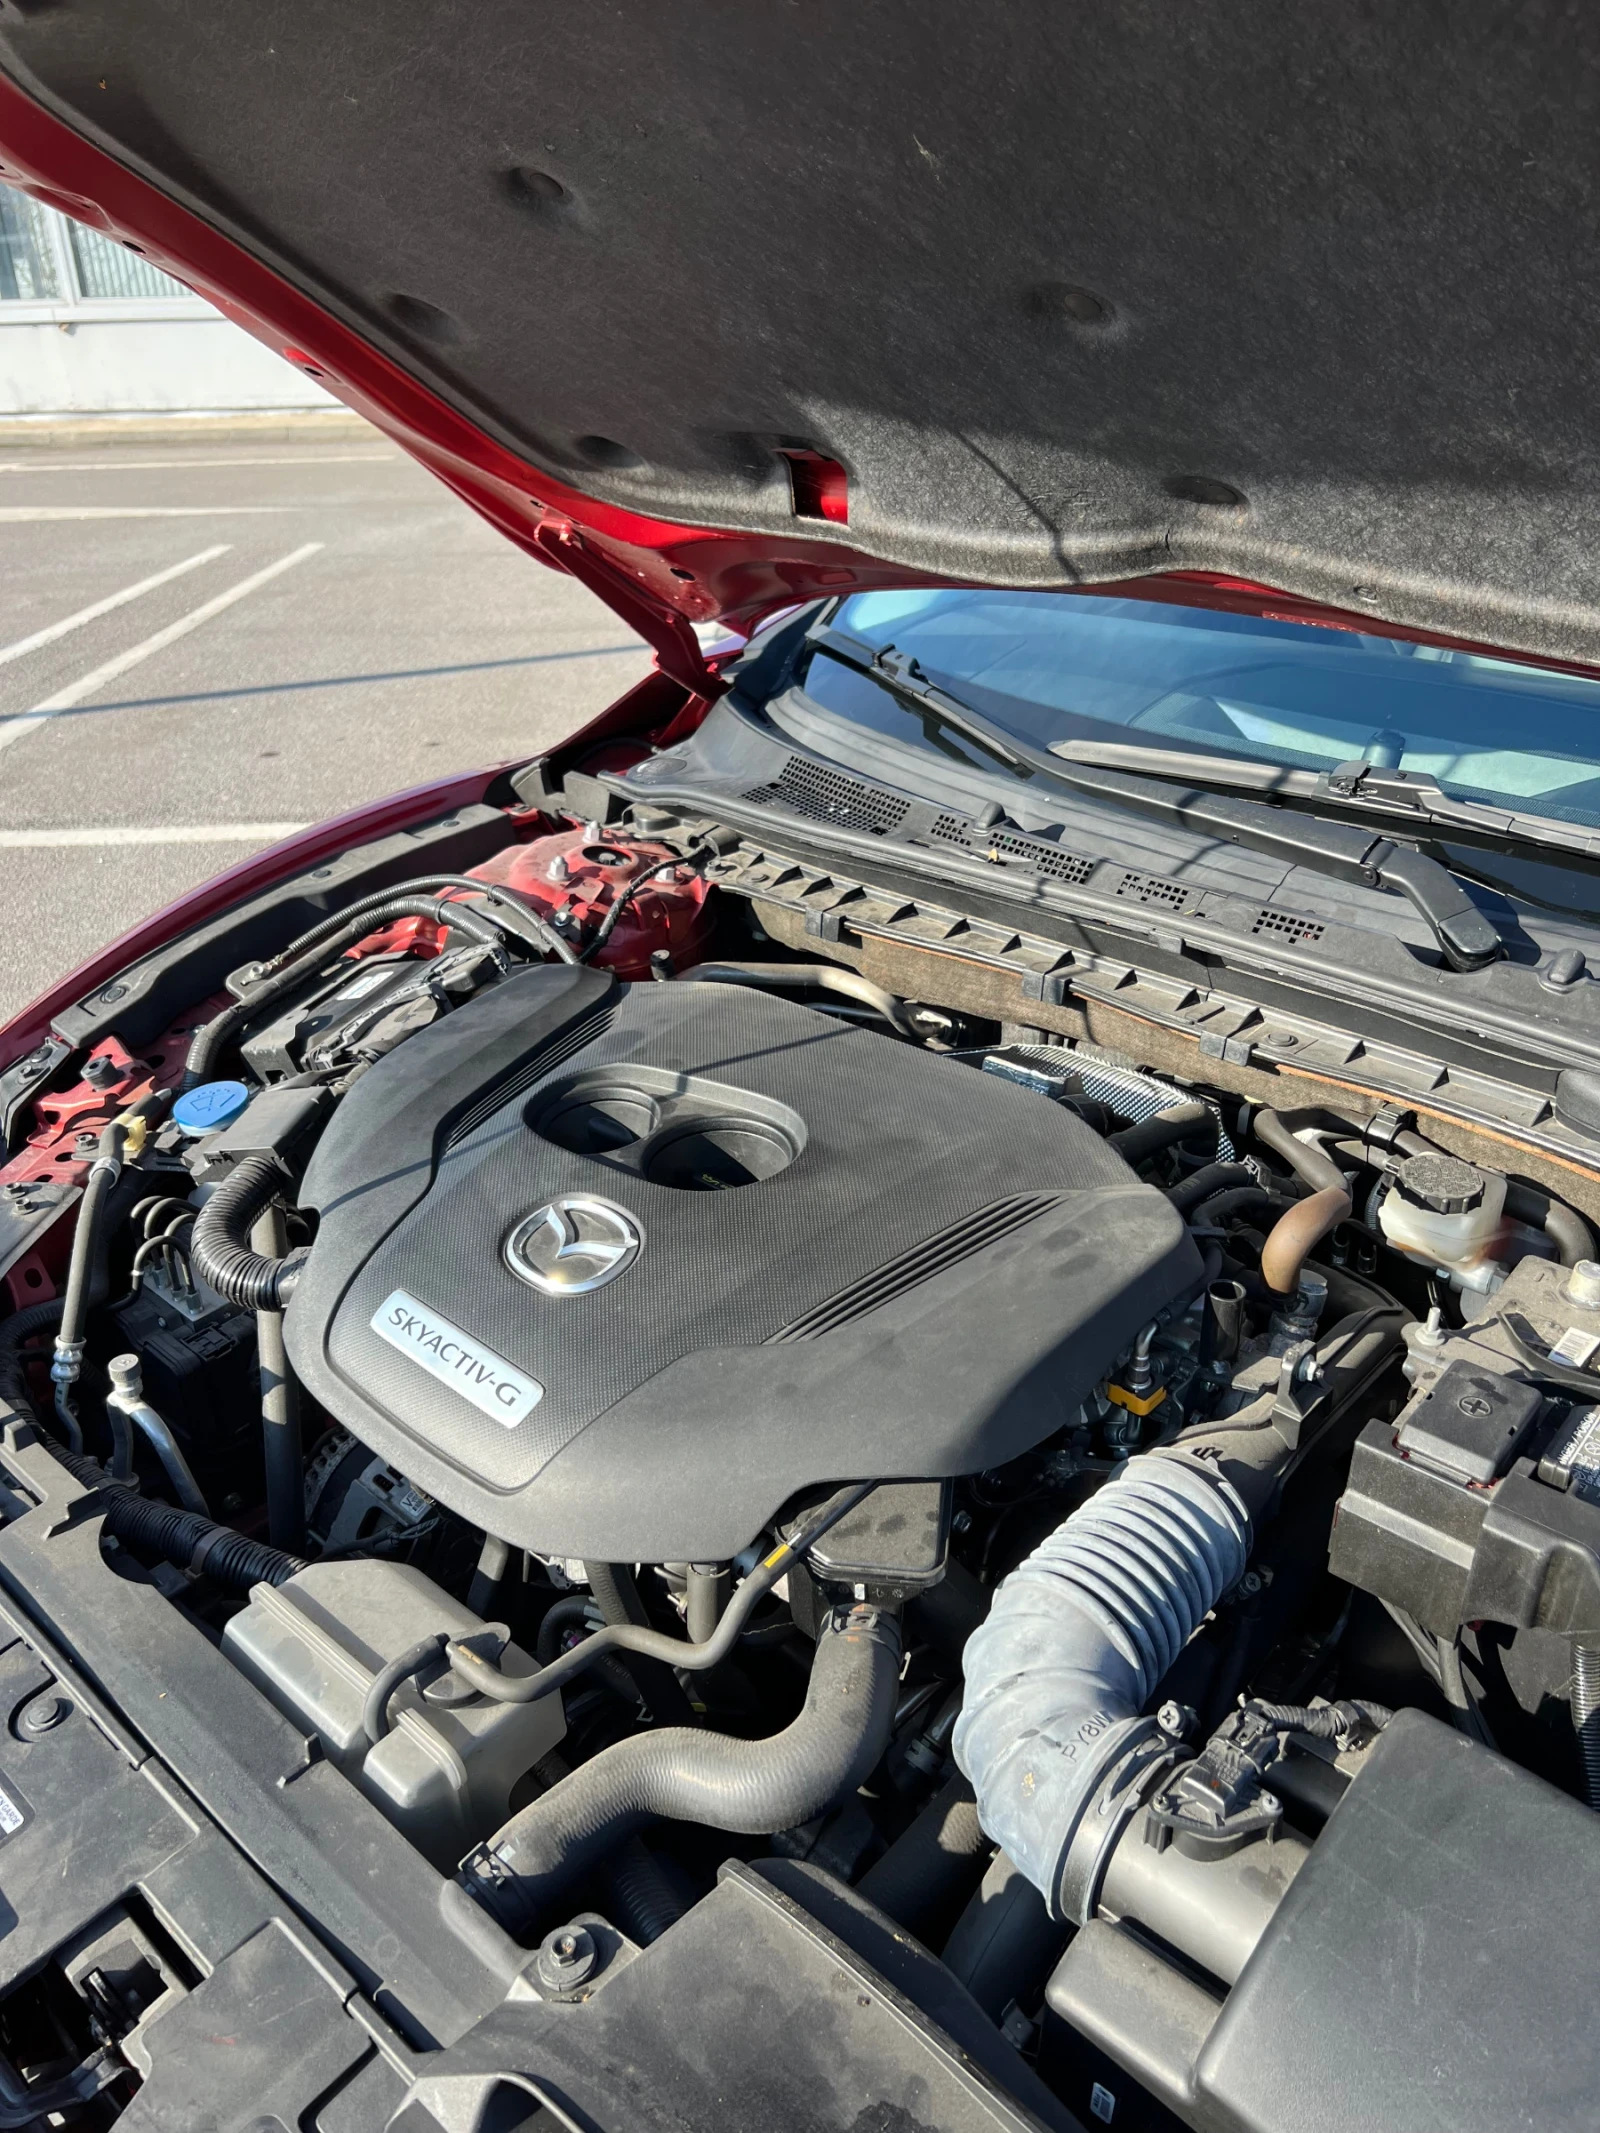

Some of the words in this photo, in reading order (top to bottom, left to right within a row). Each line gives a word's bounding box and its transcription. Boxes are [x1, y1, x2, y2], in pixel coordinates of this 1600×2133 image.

[388, 1307, 522, 1407] SKYACTIV-G
[1573, 1411, 1597, 1438] POISON
[1061, 1709, 1115, 1763] PY8W
[2, 1804, 21, 1826] GARDE
